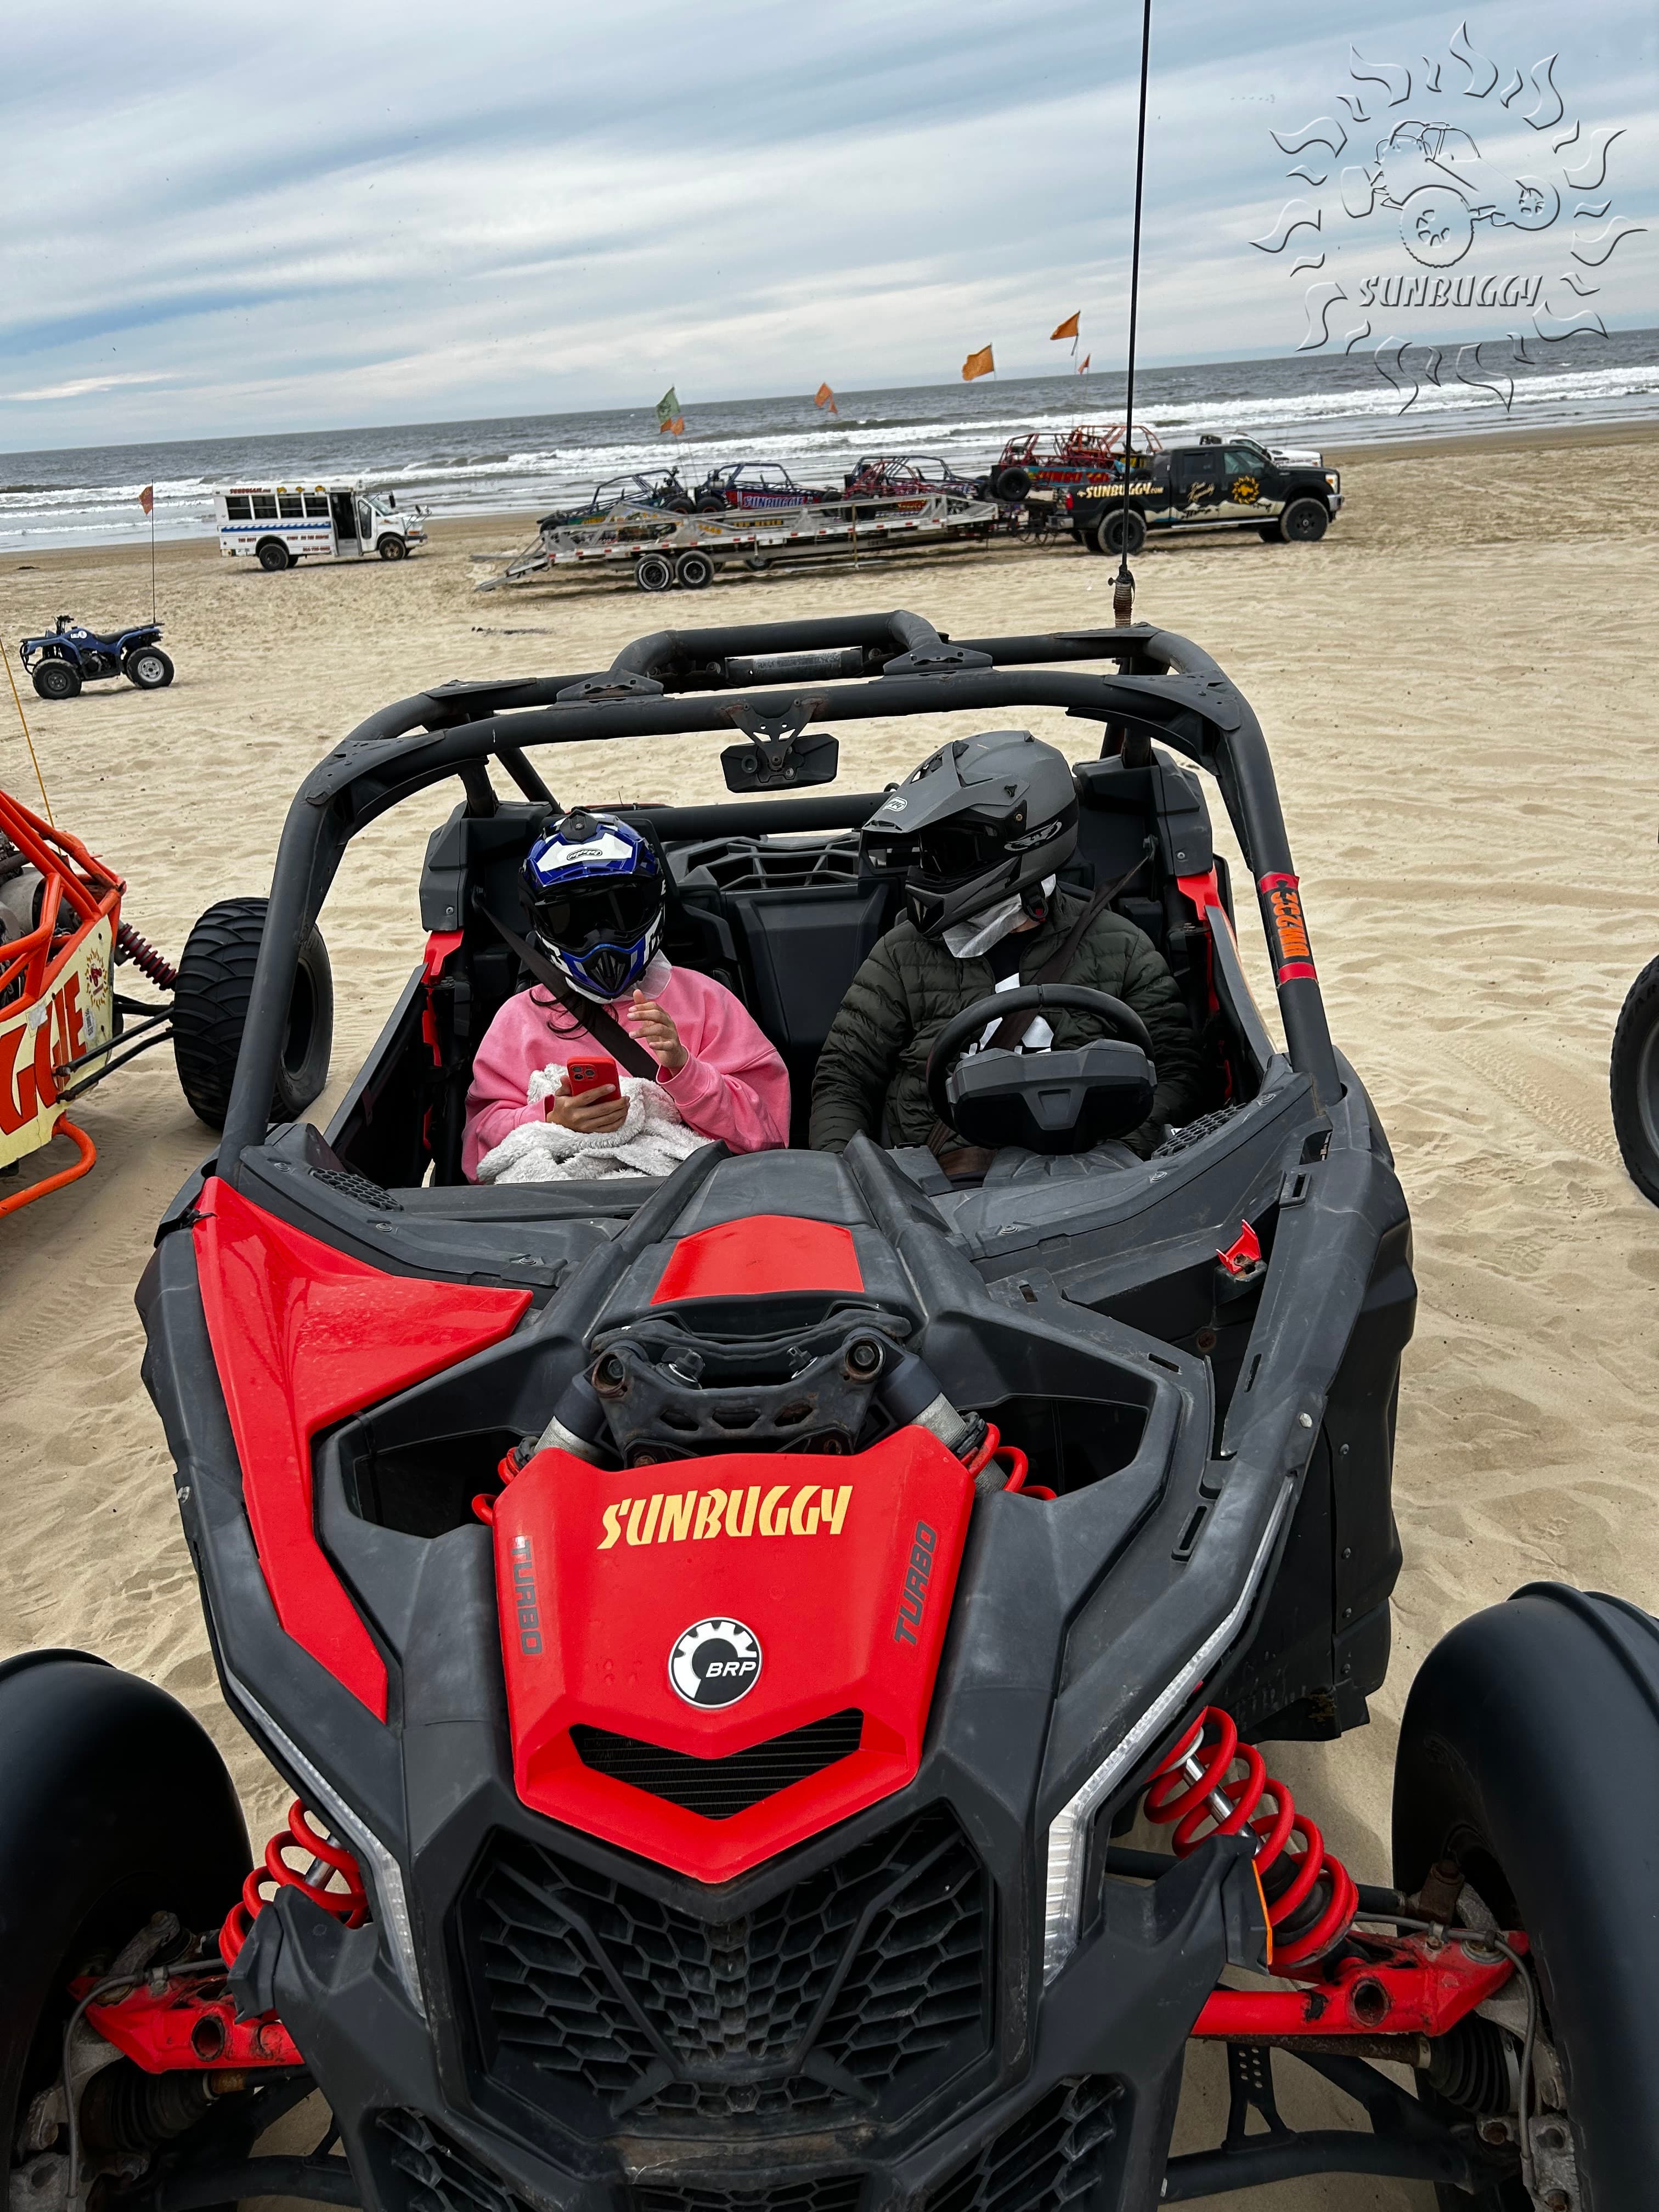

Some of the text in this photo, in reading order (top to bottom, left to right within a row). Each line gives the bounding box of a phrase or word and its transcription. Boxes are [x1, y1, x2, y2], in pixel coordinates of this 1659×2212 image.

[596, 1485, 853, 1550] SUNBUGGY
[511, 1537, 543, 1656] TURBO
[894, 1520, 938, 1646] TURBO
[705, 1660, 757, 1678] BRP
